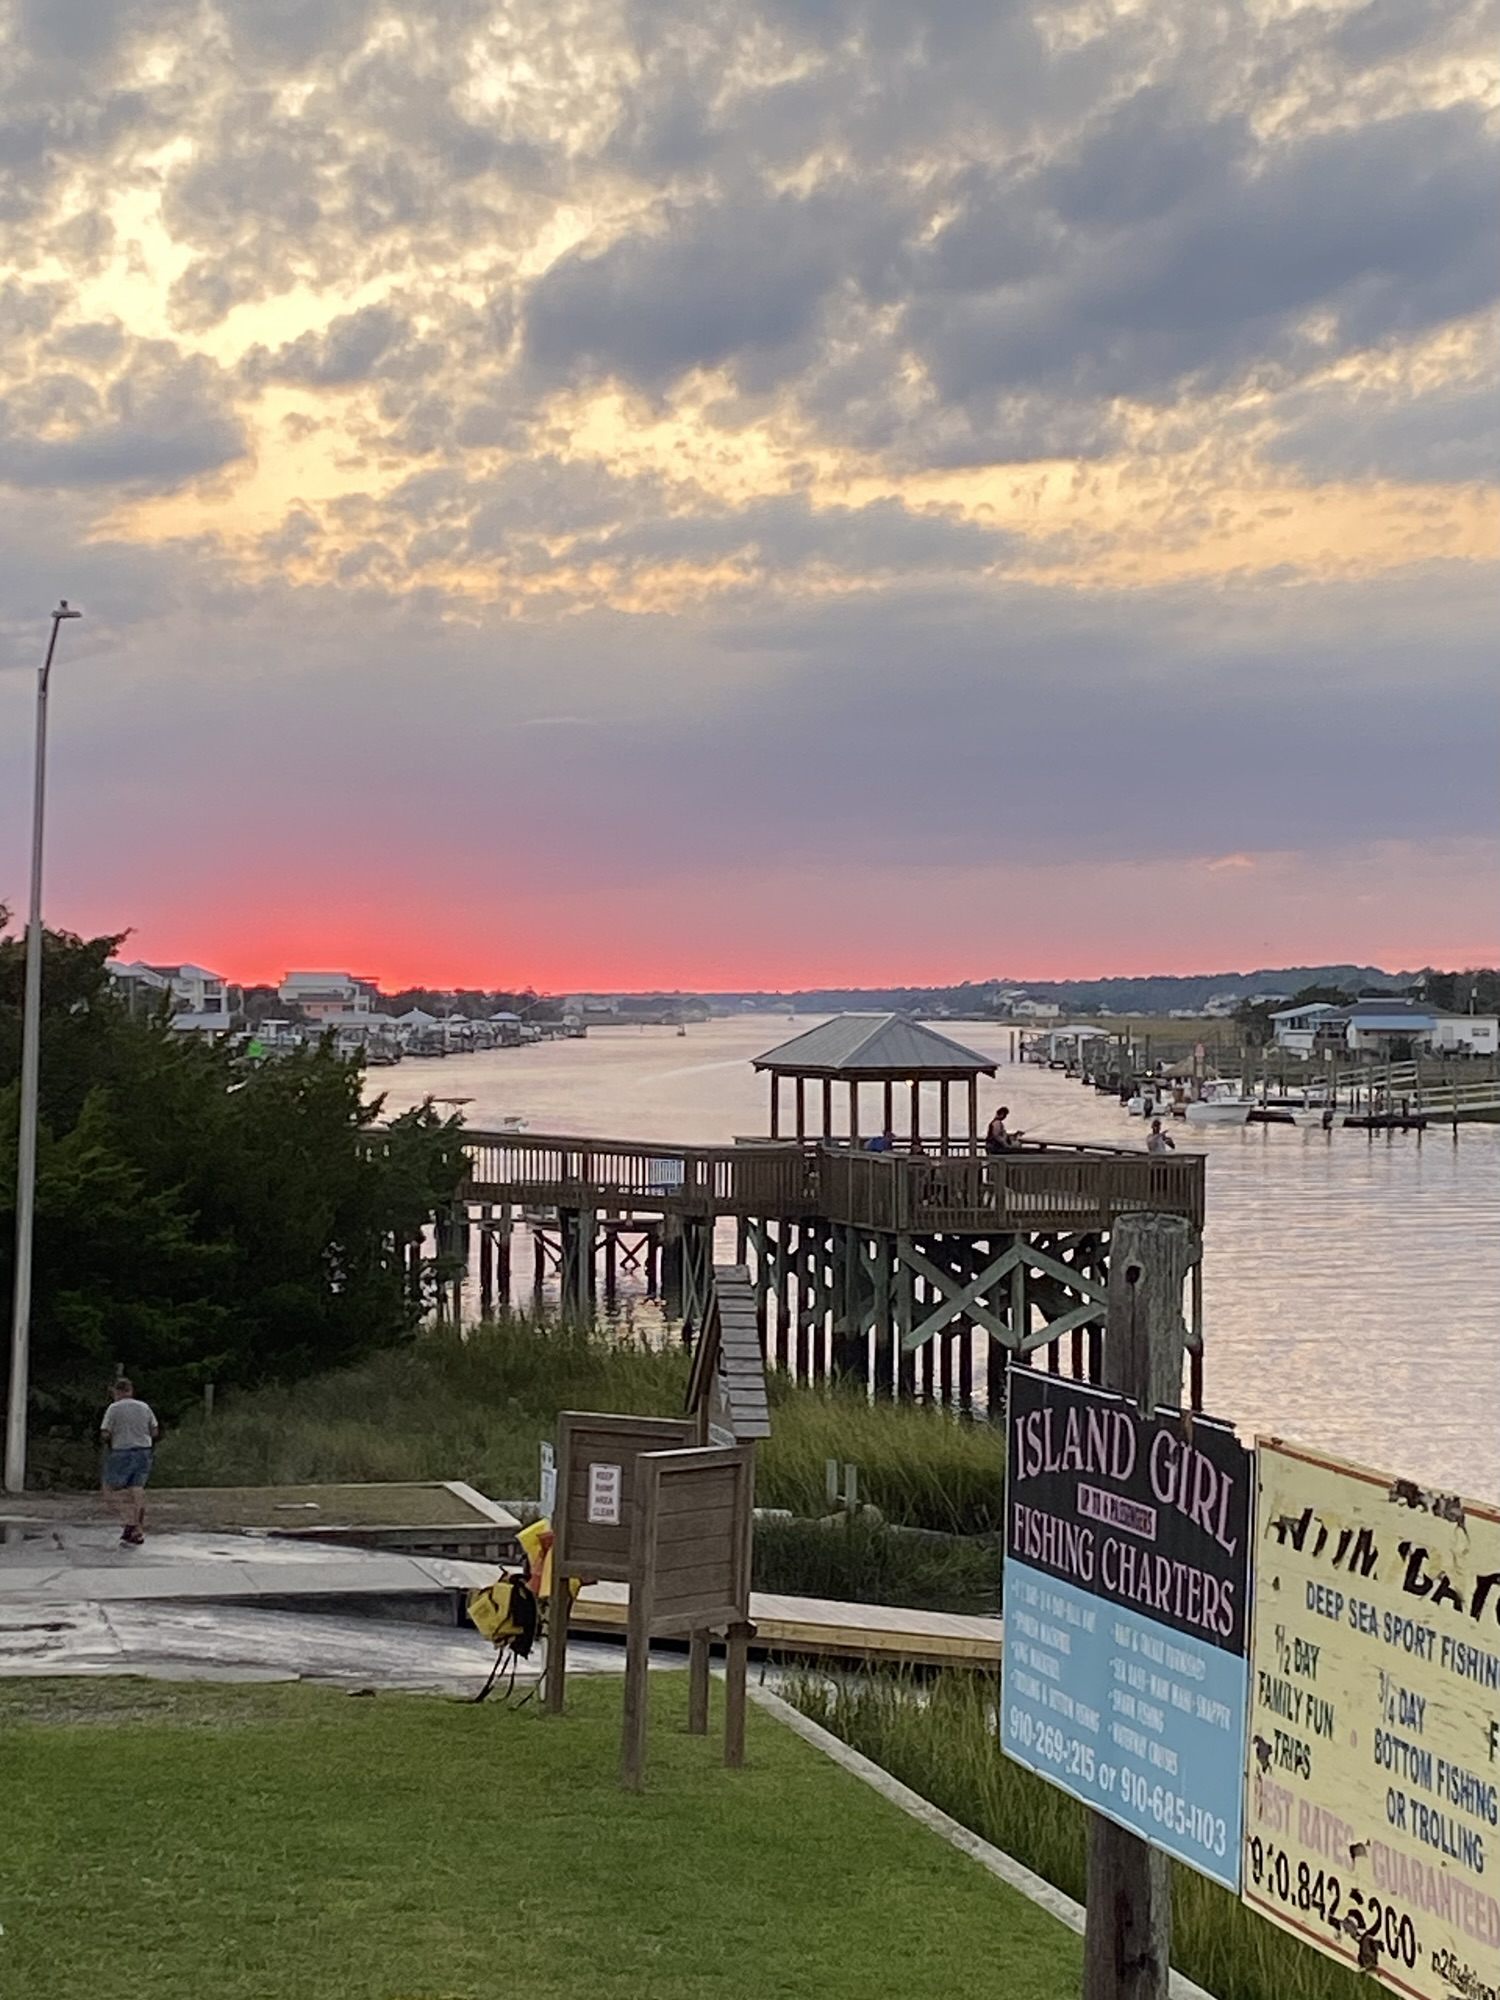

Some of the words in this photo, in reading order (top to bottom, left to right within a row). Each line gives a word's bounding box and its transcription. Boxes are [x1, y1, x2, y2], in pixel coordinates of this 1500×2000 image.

[1015, 1405, 1136, 1481] ISLAND
[1151, 1429, 1237, 1558] GIRL
[1013, 1502, 1094, 1581] FISHING
[1101, 1537, 1234, 1637] CHARTERS
[1294, 1637, 1320, 1681] DAY
[1306, 1580, 1344, 1621] DEEP
[1349, 1598, 1379, 1639] SEA
[1383, 1611, 1436, 1662] SPORT
[1441, 1634, 1500, 1690] FISHIN
[1258, 1670, 1304, 1725] FAMILY
[1306, 1693, 1335, 1741] FUN
[1399, 1687, 1426, 1735] DAY
[1274, 1728, 1312, 1781] TRIPS
[1374, 1727, 1432, 1792] BOTTOM
[1437, 1757, 1498, 1826] FISHING
[1099, 1763, 1116, 1791] or
[1120, 1767, 1226, 1857] 910-685-1103
[1386, 1787, 1406, 1830] OR
[1410, 1798, 1484, 1874] TROLLING
